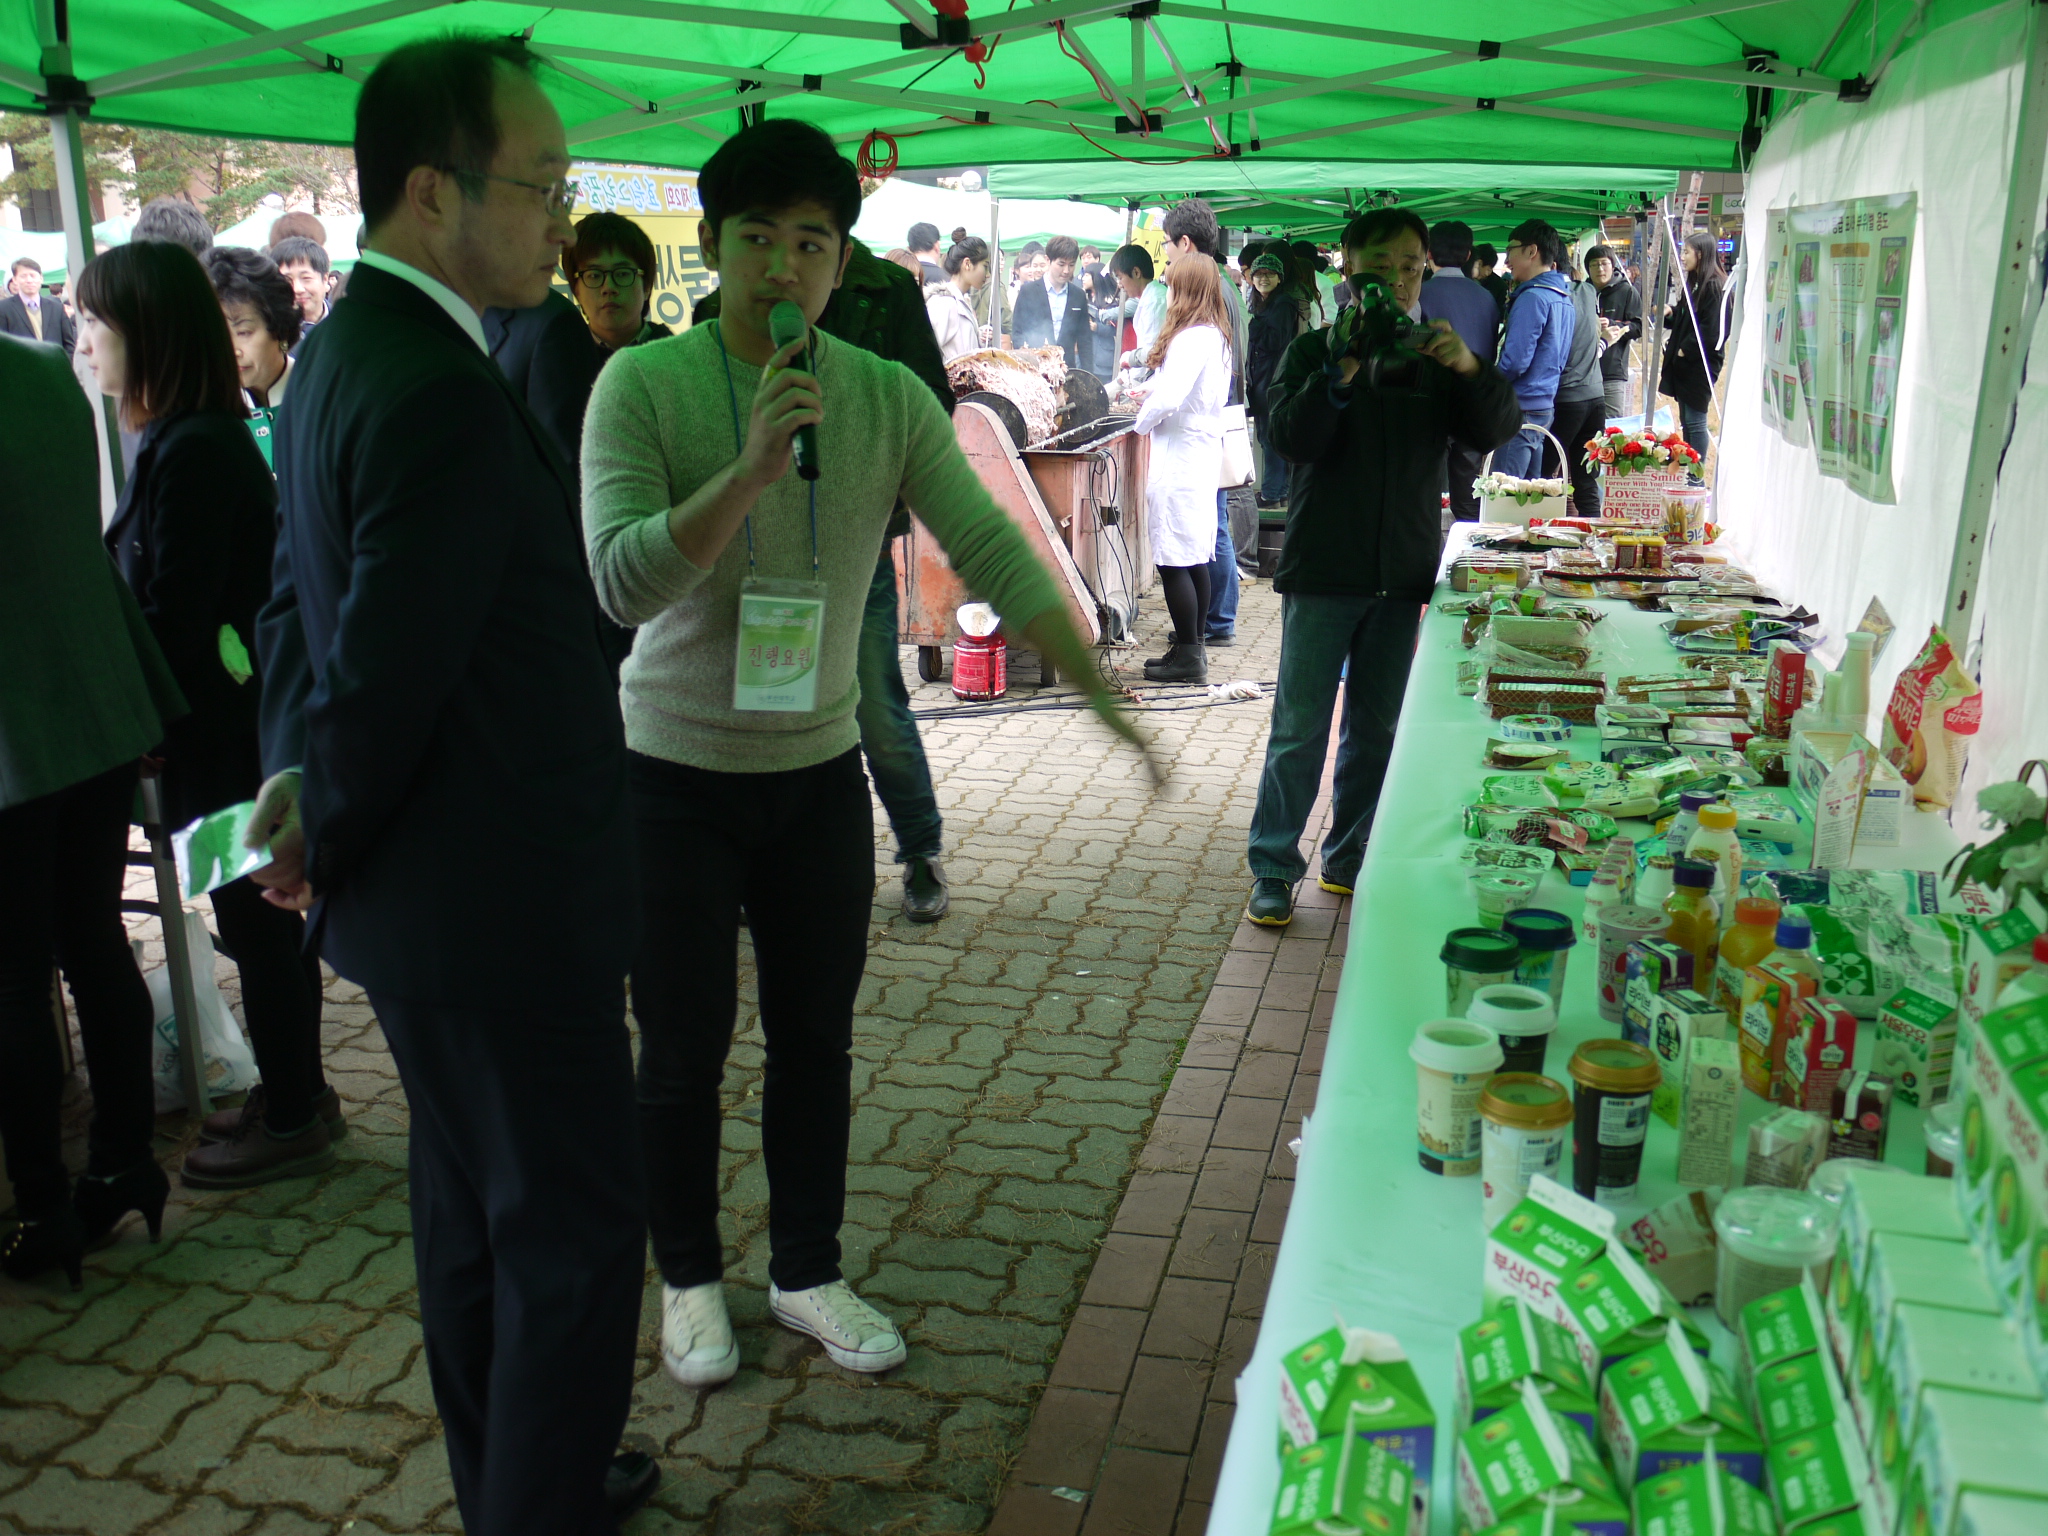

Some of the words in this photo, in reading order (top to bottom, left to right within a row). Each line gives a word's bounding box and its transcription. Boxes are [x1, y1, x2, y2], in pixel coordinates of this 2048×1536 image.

[1651, 472, 1683, 482] Smile
[1605, 486, 1640, 499] Love
[1603, 507, 1625, 518] OK
[1641, 508, 1660, 520] go
[747, 644, 811, 670] 진행요원
[1784, 672, 1797, 704] 치즈육포
